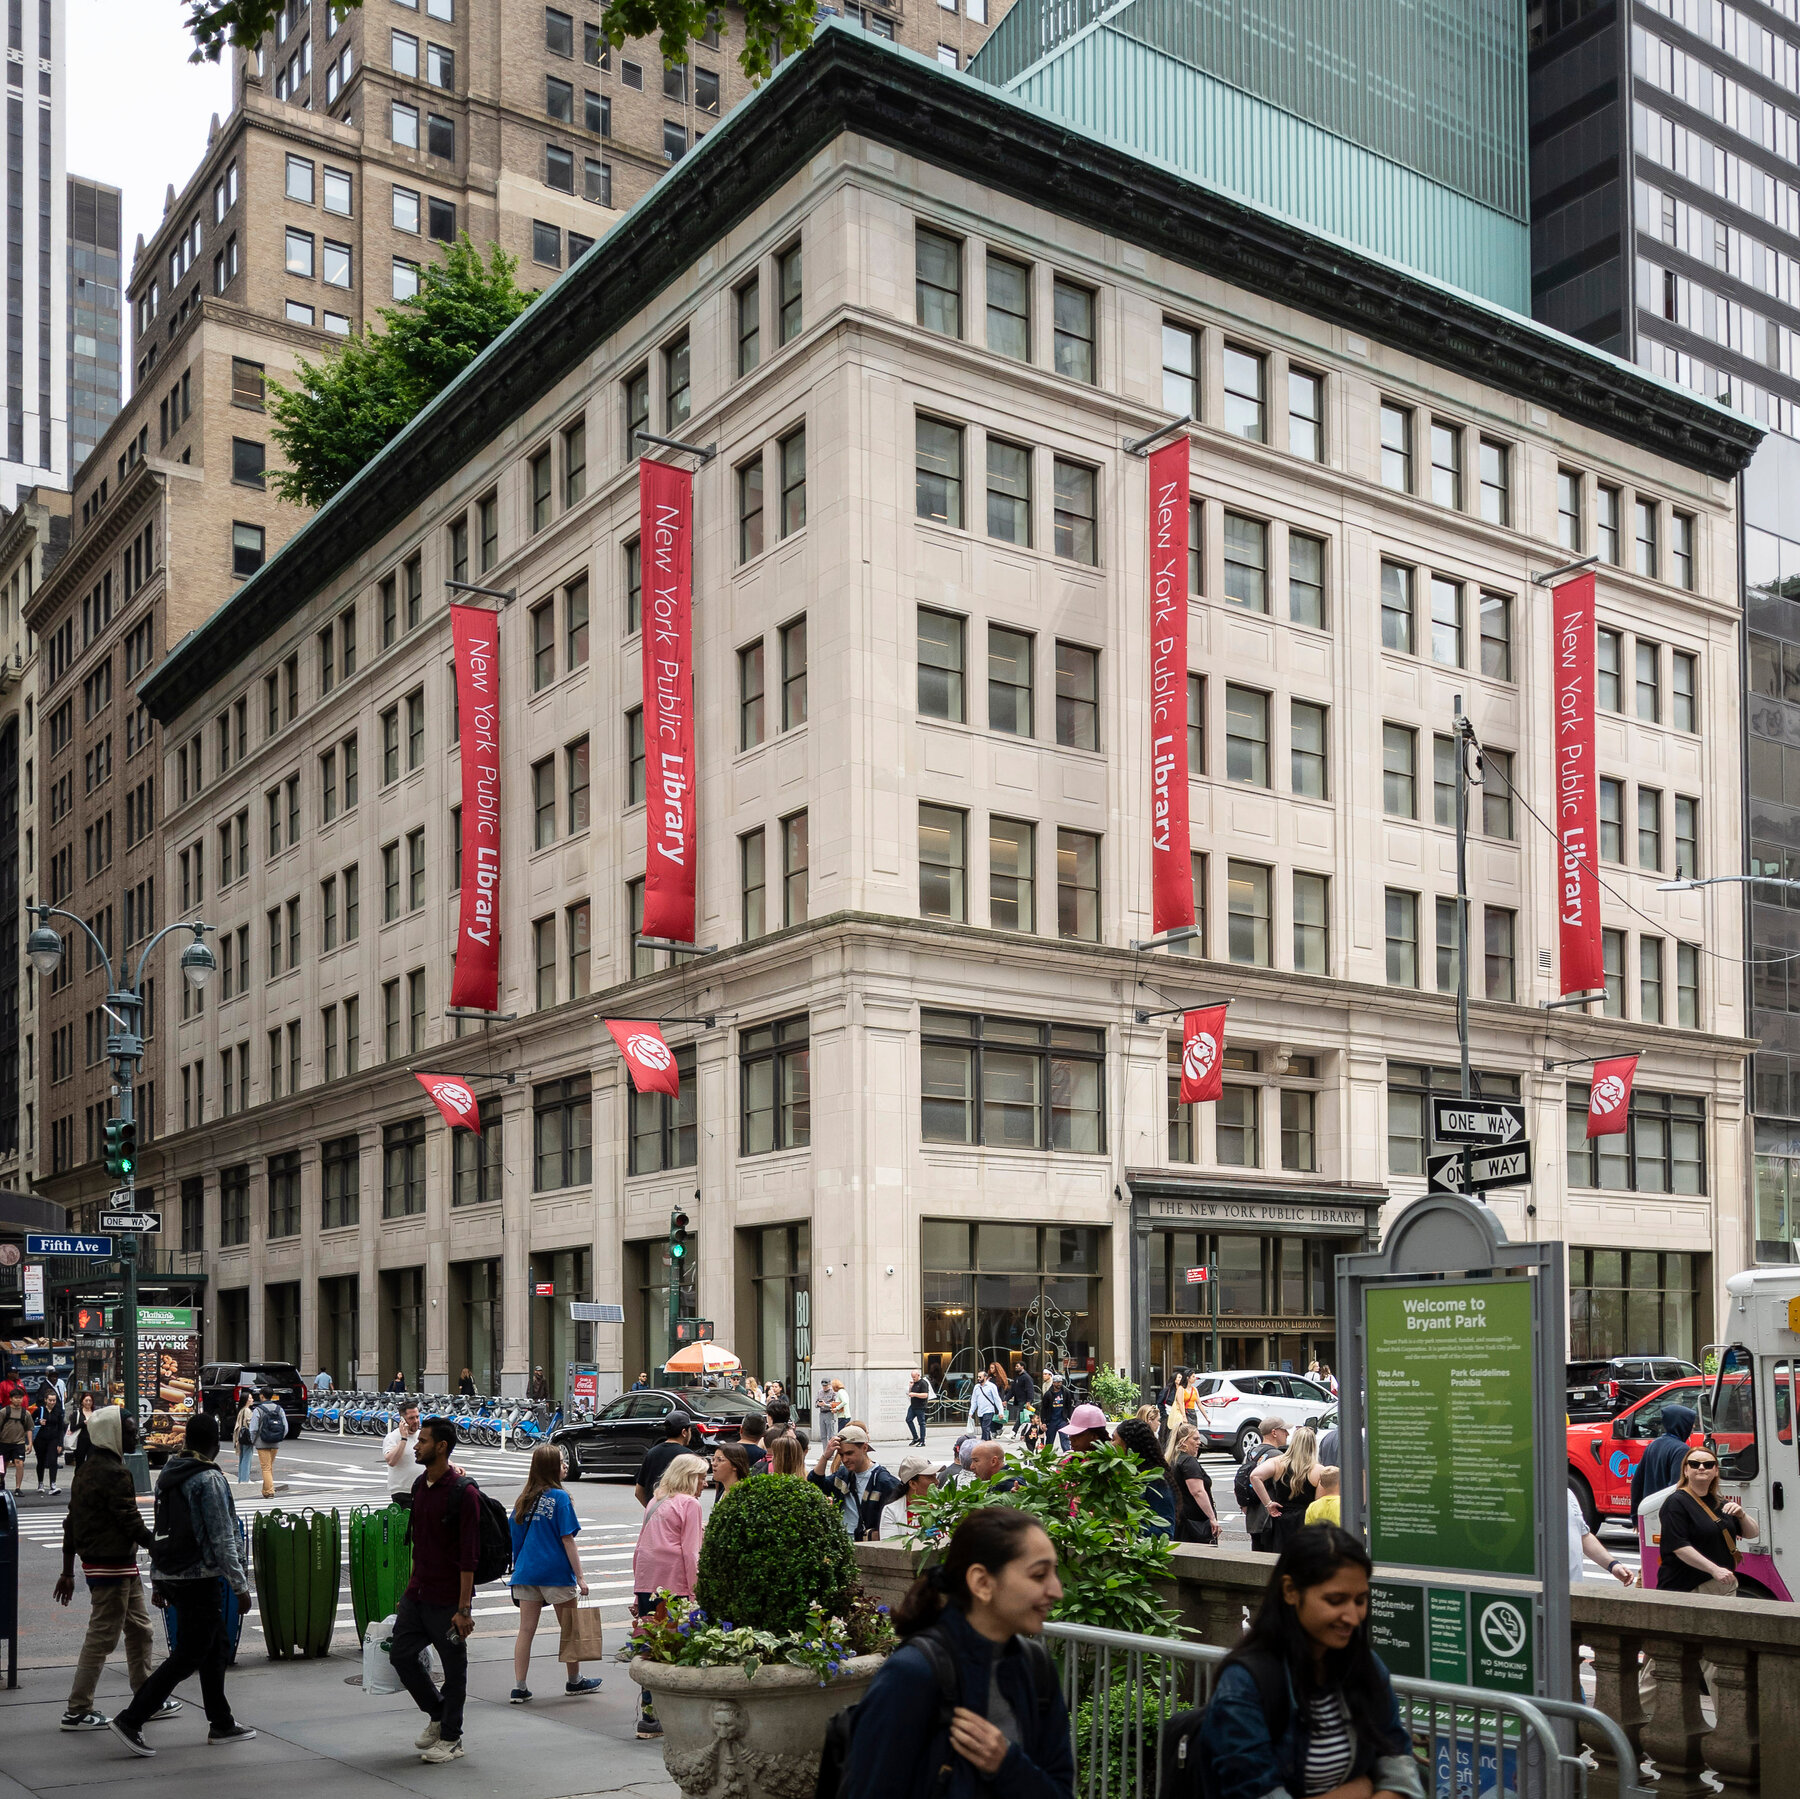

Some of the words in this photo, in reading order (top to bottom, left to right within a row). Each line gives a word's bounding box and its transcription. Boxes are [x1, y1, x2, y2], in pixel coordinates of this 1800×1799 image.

[1156, 481, 1178, 549] New
[656, 504, 680, 572] New
[1155, 558, 1177, 627] York
[655, 586, 680, 646] York
[1561, 610, 1584, 668] New
[468, 638, 491, 693] New
[1154, 636, 1176, 724] Public
[658, 658, 683, 740] Public
[1561, 675, 1584, 735] York
[474, 703, 497, 755] York
[1561, 743, 1585, 816] Public
[477, 764, 498, 836] Public
[1154, 734, 1176, 851] Library
[657, 752, 687, 866] Library
[1562, 827, 1586, 927] Library
[467, 846, 498, 947] Library
[1448, 1113, 1476, 1131] ONE
[1487, 1116, 1513, 1134] WAY
[1447, 1164, 1474, 1183] ON
[1488, 1155, 1520, 1177] WAY
[106, 1217, 124, 1226] ONE
[131, 1218, 150, 1227] WAY
[1157, 1201, 1184, 1215] THE
[1190, 1203, 1218, 1216] NEW
[1222, 1204, 1256, 1218] YORK
[1261, 1206, 1305, 1221] PUBLIC
[1311, 1208, 1358, 1223] LIBRARY
[40, 1239, 72, 1252] Fifth
[74, 1240, 99, 1252] Ave
[1402, 1298, 1467, 1313] Welcome
[1470, 1297, 1486, 1311] to
[1160, 1319, 1195, 1328] STAVROS
[1197, 1319, 1237, 1328] NIACHOS
[1239, 1320, 1288, 1329] FOUNDATION
[1291, 1320, 1321, 1329] LIBRARY
[1406, 1315, 1452, 1332] Bryant
[1455, 1313, 1486, 1329] Park
[137, 1341, 156, 1350] EW
[1376, 1369, 1391, 1377] You
[1392, 1369, 1405, 1377] Are
[1377, 1379, 1410, 1387] Welcome
[1411, 1379, 1420, 1387] to
[1450, 1369, 1468, 1377] Park
[1469, 1369, 1510, 1377] Guidelines
[1450, 1378, 1481, 1387] Prohibit
[1610, 1495, 1631, 1506] Industria
[1371, 1588, 1388, 1599] May
[1371, 1599, 1415, 1611] September
[1371, 1608, 1395, 1618] Hours
[1372, 1625, 1393, 1637] Daily,
[1480, 1658, 1492, 1666] NO
[1493, 1660, 1528, 1671] SMOKING
[1493, 1671, 1507, 1679] any
[1507, 1671, 1524, 1680] kind
[1437, 1745, 1470, 1765] Ats
[1438, 1764, 1482, 1785] Caft
